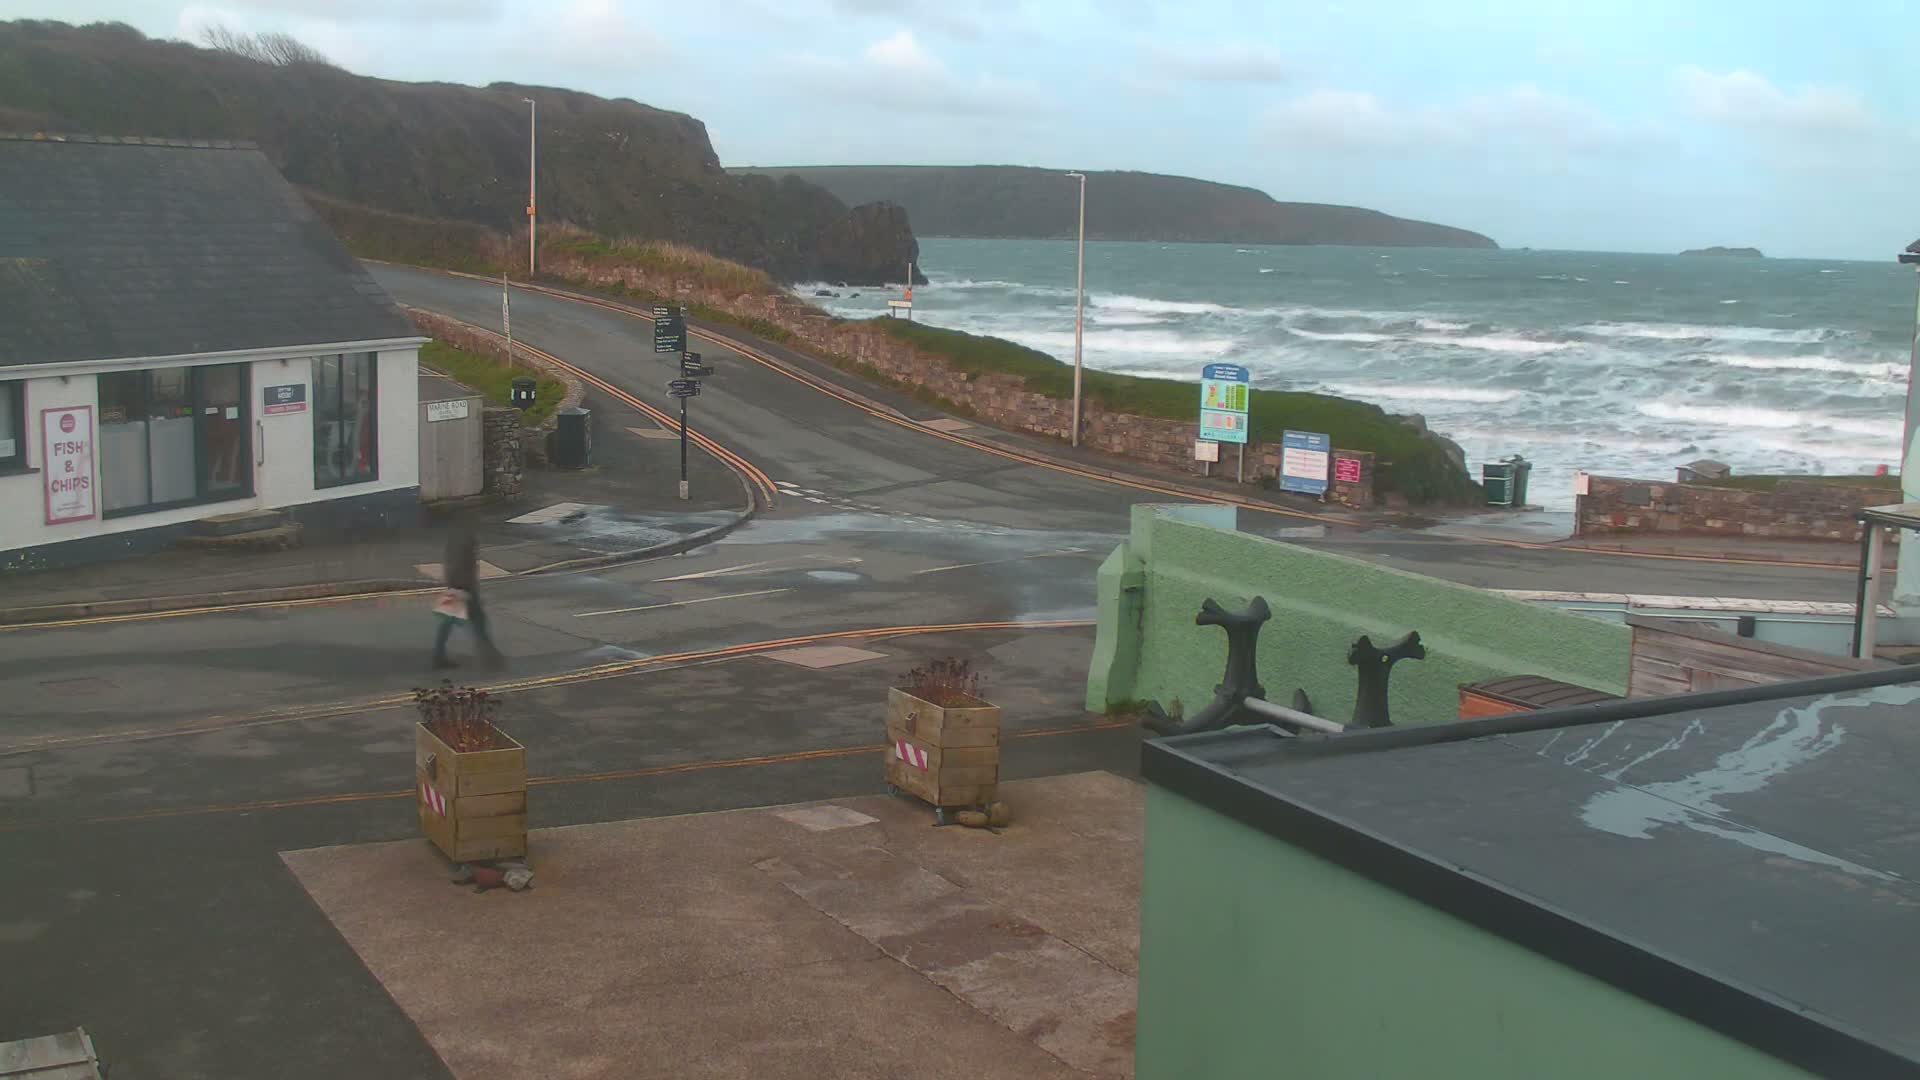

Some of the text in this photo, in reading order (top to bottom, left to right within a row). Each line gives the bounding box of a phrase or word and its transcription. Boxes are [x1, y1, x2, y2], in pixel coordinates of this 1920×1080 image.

[452, 400, 467, 408] ROAD
[54, 440, 83, 456] FISH
[64, 460, 75, 472] &
[51, 476, 89, 493] CHIPS
